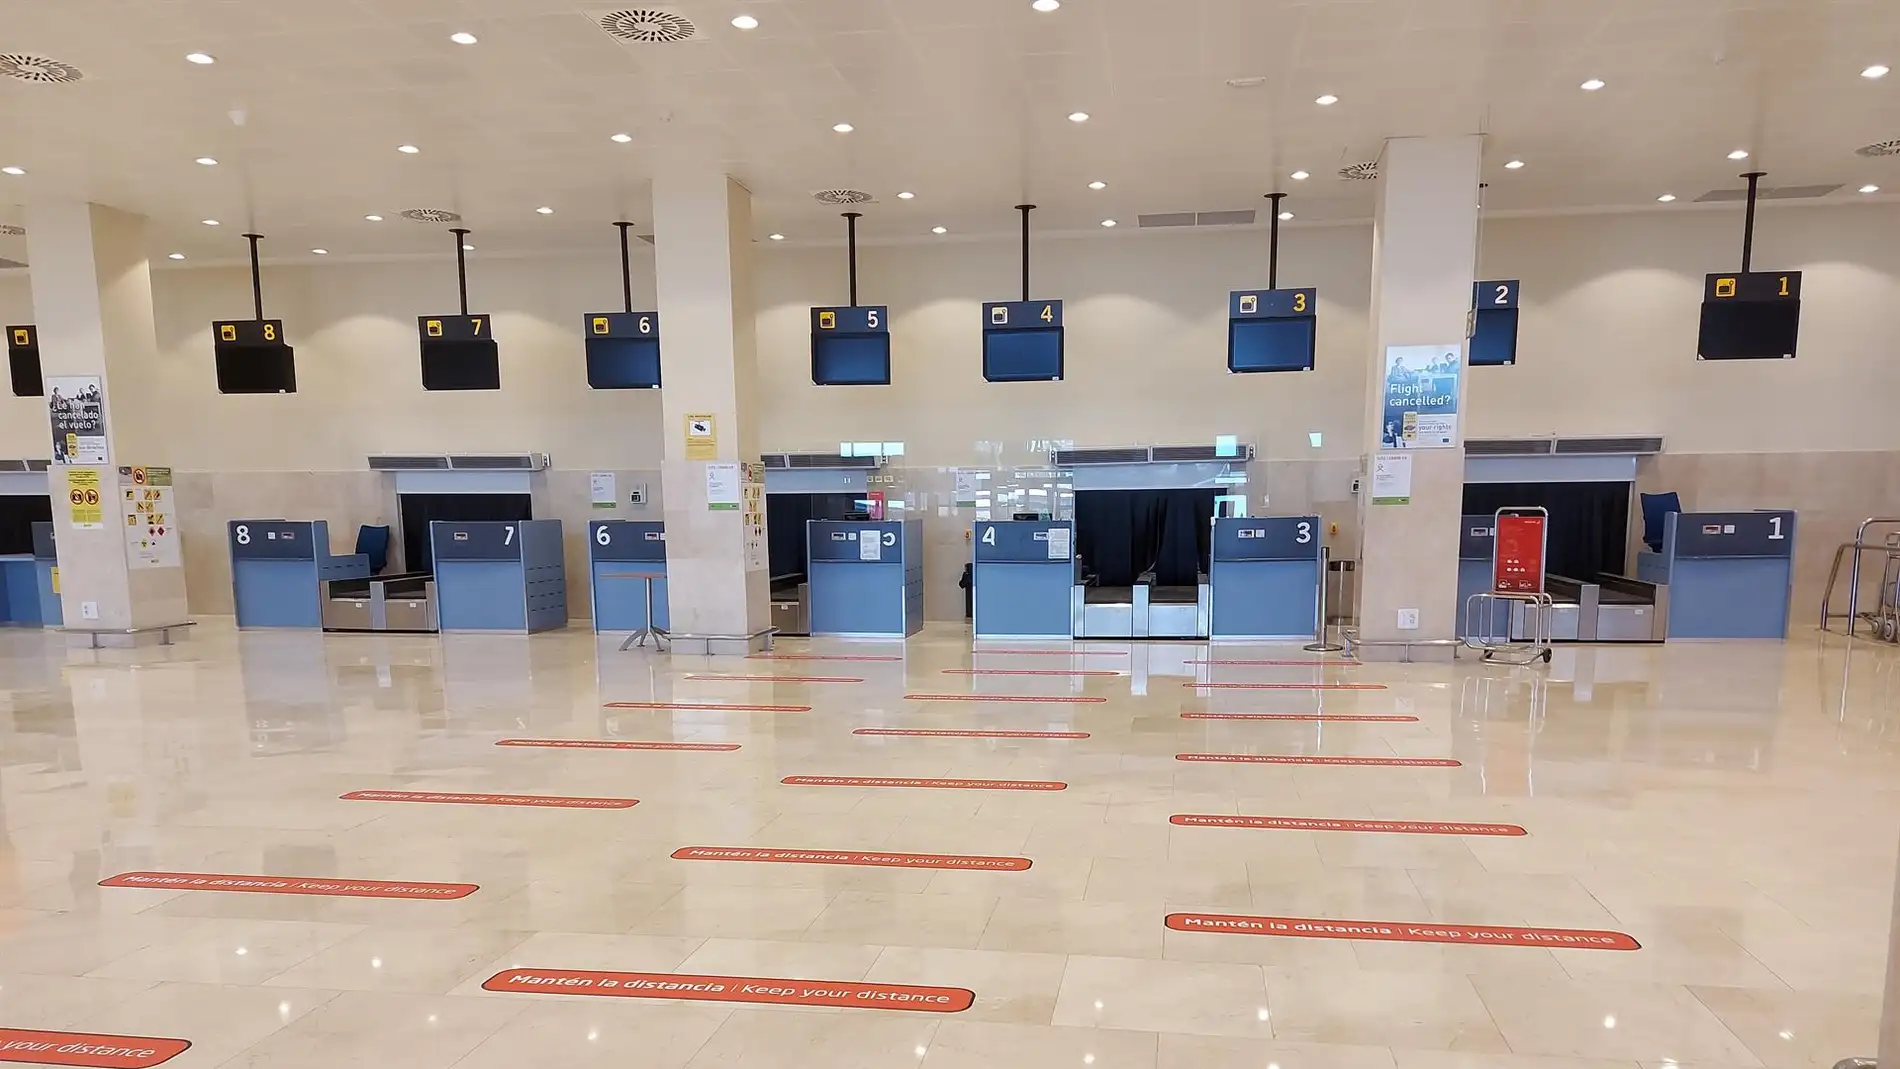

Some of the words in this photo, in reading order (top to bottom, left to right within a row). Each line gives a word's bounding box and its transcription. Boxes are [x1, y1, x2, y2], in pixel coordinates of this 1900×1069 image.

[1494, 285, 1509, 305] 2
[1778, 276, 1790, 296] 1
[1292, 293, 1307, 312] 3
[867, 310, 879, 328] 5
[1040, 304, 1054, 323] 4
[263, 323, 276, 341] 8
[471, 318, 483, 336] 7
[639, 316, 651, 334] 6
[69, 399, 85, 410] han
[1389, 395, 1451, 407] cancelled?
[58, 411, 99, 420] cancelado
[59, 420, 68, 430] el
[68, 420, 96, 429] vuelo?
[236, 524, 251, 545] 8
[504, 526, 516, 545] 7
[596, 525, 611, 546] 6
[981, 525, 996, 547] 4
[1295, 521, 1311, 544] 3
[1767, 516, 1785, 540] 1
[755, 851, 770, 859] la
[774, 851, 849, 861] distancia
[861, 855, 901, 863] Keep
[905, 857, 941, 865] your
[946, 858, 1016, 868] distance
[188, 878, 204, 886] la
[208, 878, 288, 889] distancia
[298, 881, 341, 891] Keep
[340, 884, 384, 893] your
[384, 885, 457, 896] distance
[1184, 917, 1263, 929] Mantén
[1269, 921, 1288, 931] la
[1294, 922, 1392, 935] distancia
[1408, 927, 1461, 939] Keep
[1467, 930, 1515, 941] your
[1521, 931, 1615, 945] distance
[508, 974, 594, 988] Mantén
[597, 978, 619, 989] la
[623, 979, 726, 993] distancia
[741, 984, 796, 998] Keep
[797, 987, 852, 999] your
[856, 988, 950, 1005] distance
[1, 1040, 57, 1051] your
[56, 1042, 156, 1058] distance
